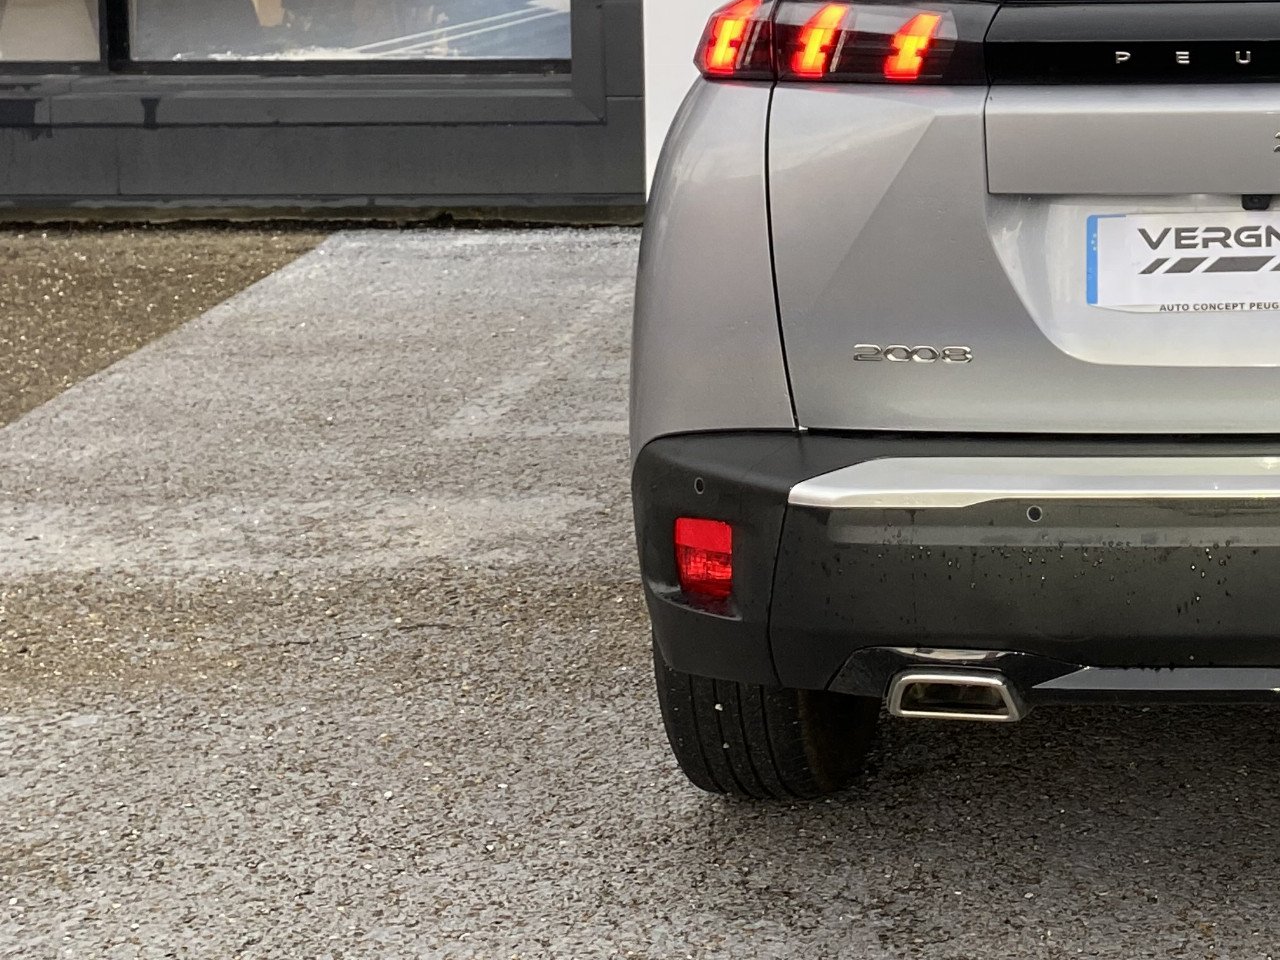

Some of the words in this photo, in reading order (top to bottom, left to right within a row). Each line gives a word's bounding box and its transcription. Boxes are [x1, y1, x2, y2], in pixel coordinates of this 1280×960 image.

[1159, 302, 1191, 313] AUTO
[1193, 302, 1246, 312] CONCEPT
[853, 343, 974, 364] 2008
